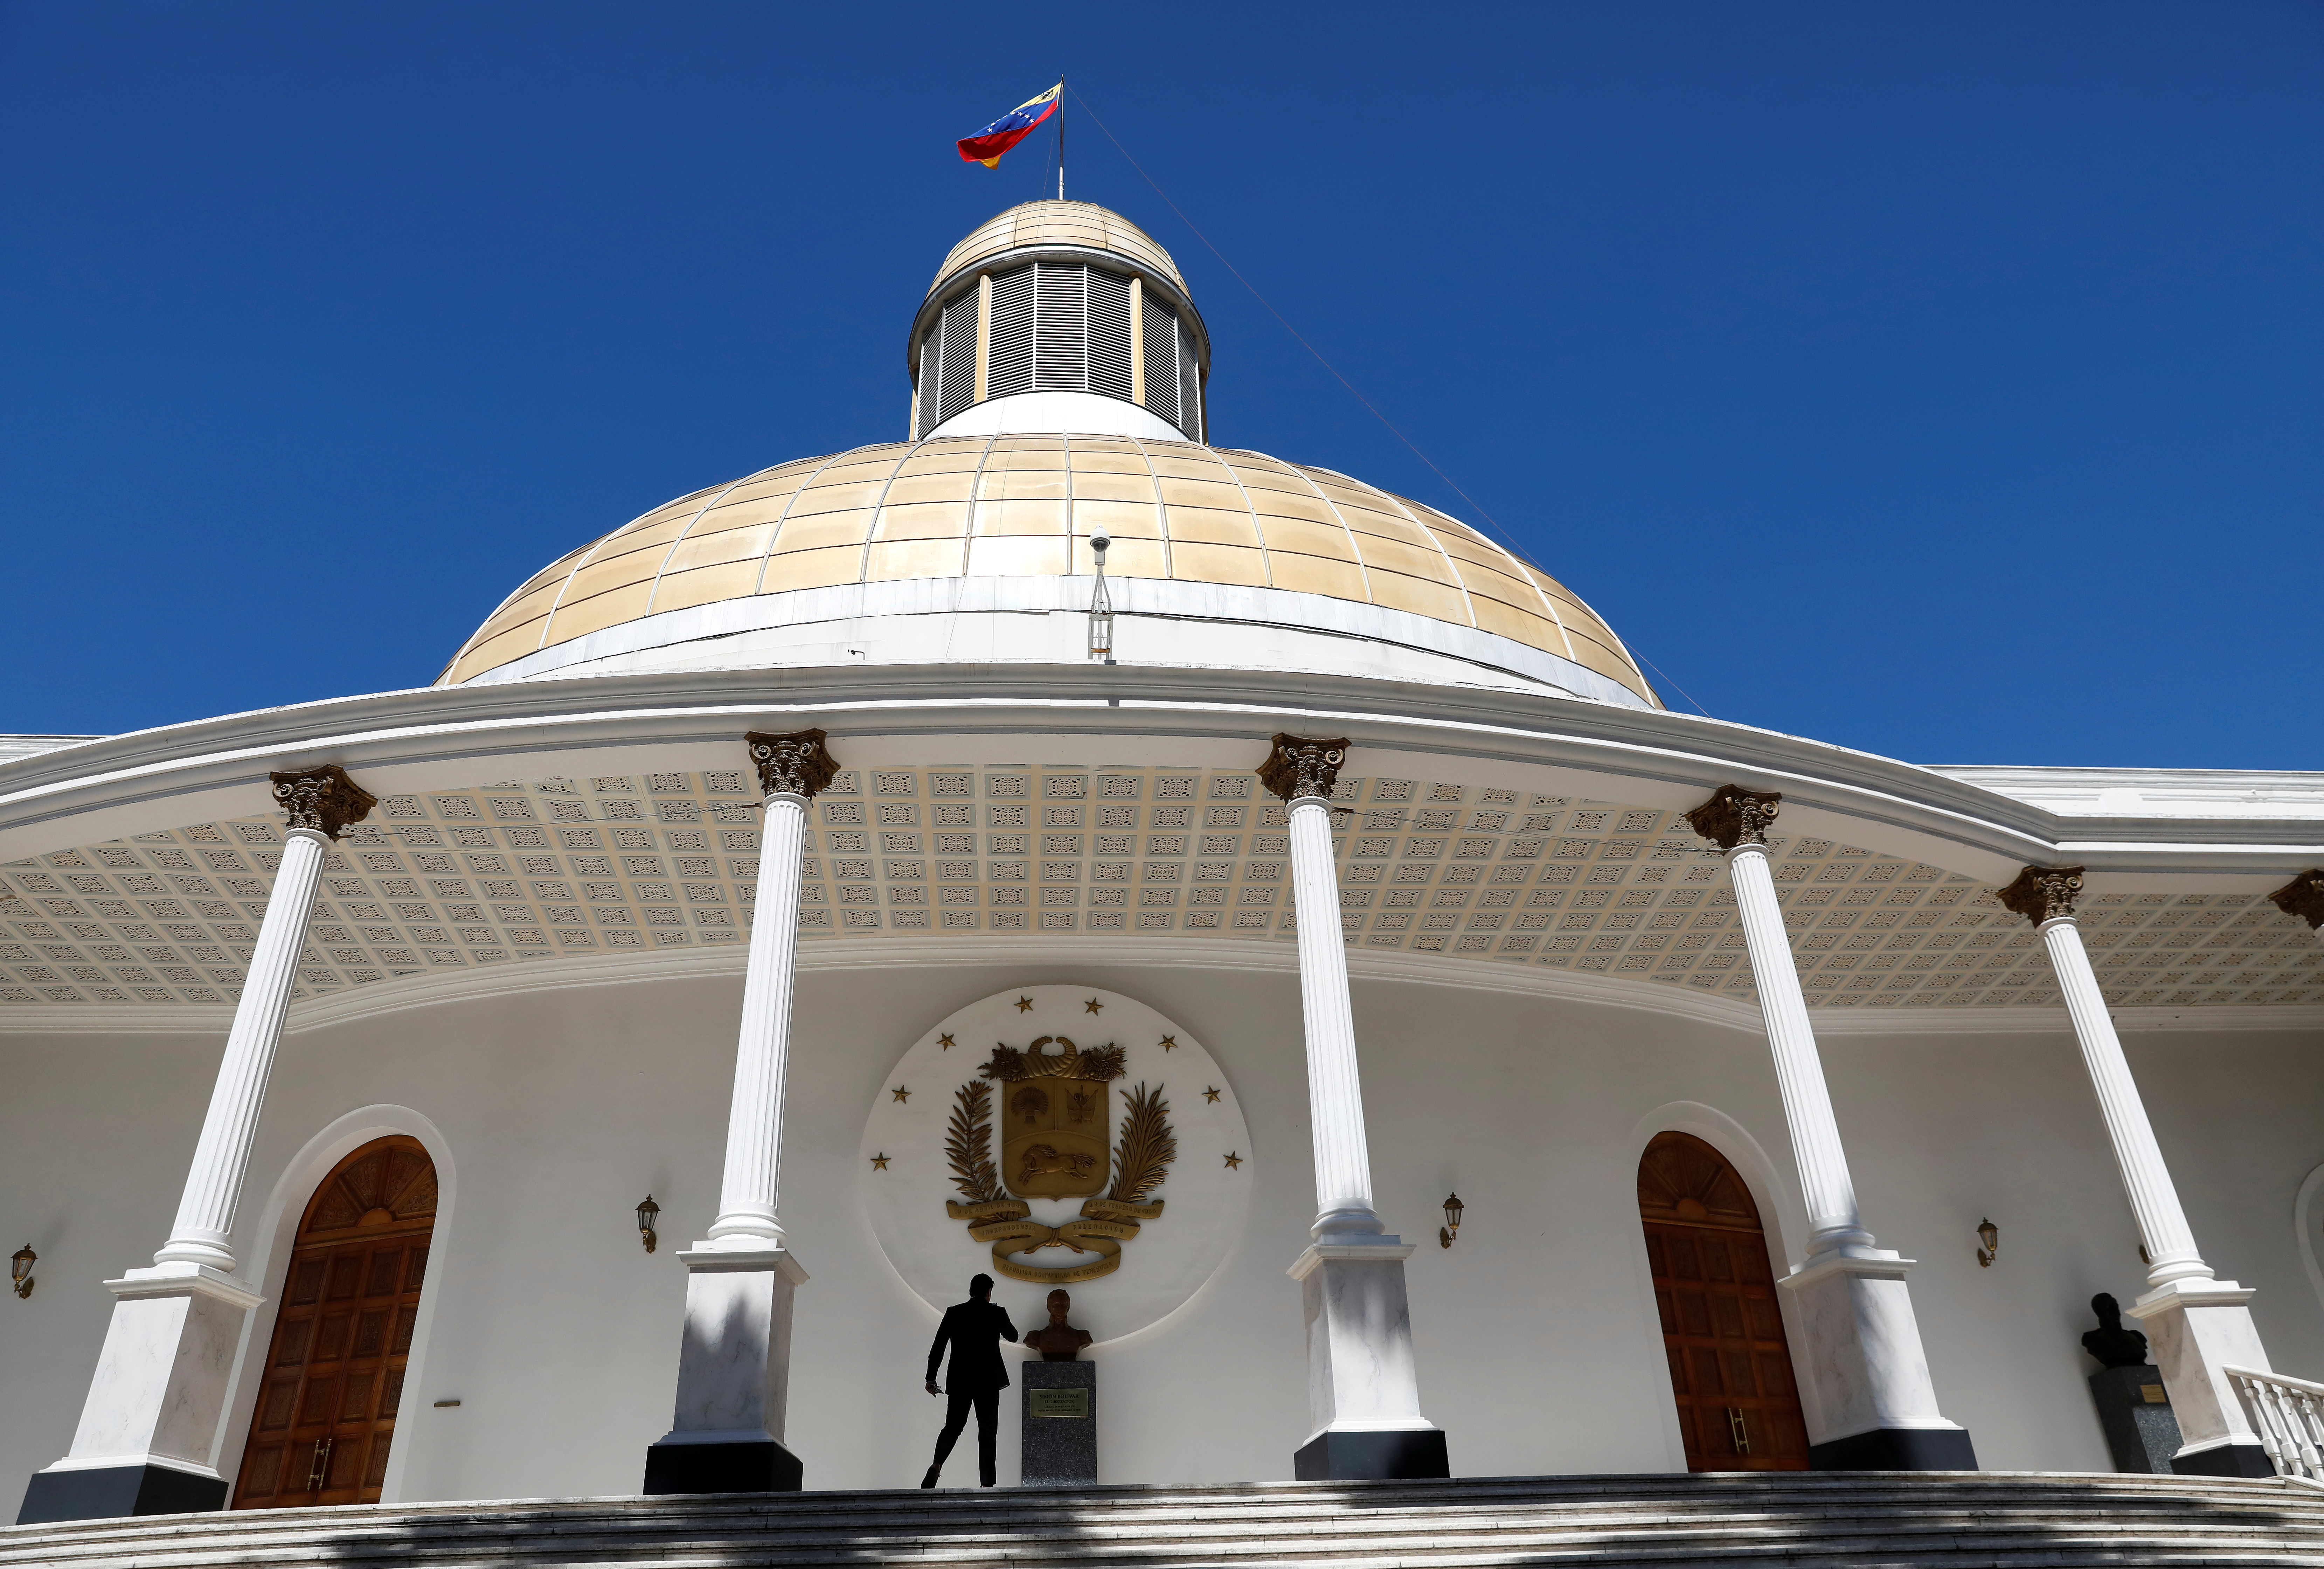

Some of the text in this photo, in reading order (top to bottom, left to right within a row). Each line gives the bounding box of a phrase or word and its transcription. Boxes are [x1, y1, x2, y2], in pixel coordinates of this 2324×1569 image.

[975, 1205, 994, 1213] ABRIL
[1108, 1202, 1133, 1211] FEBRERO
[982, 1224, 1036, 1235] INDEPENDENCIA
[1073, 1224, 1124, 1233] FEDERACIÓN
[1002, 1263, 1032, 1276] REPÚBLICA
[1082, 1262, 1113, 1275] VENEZUELA
